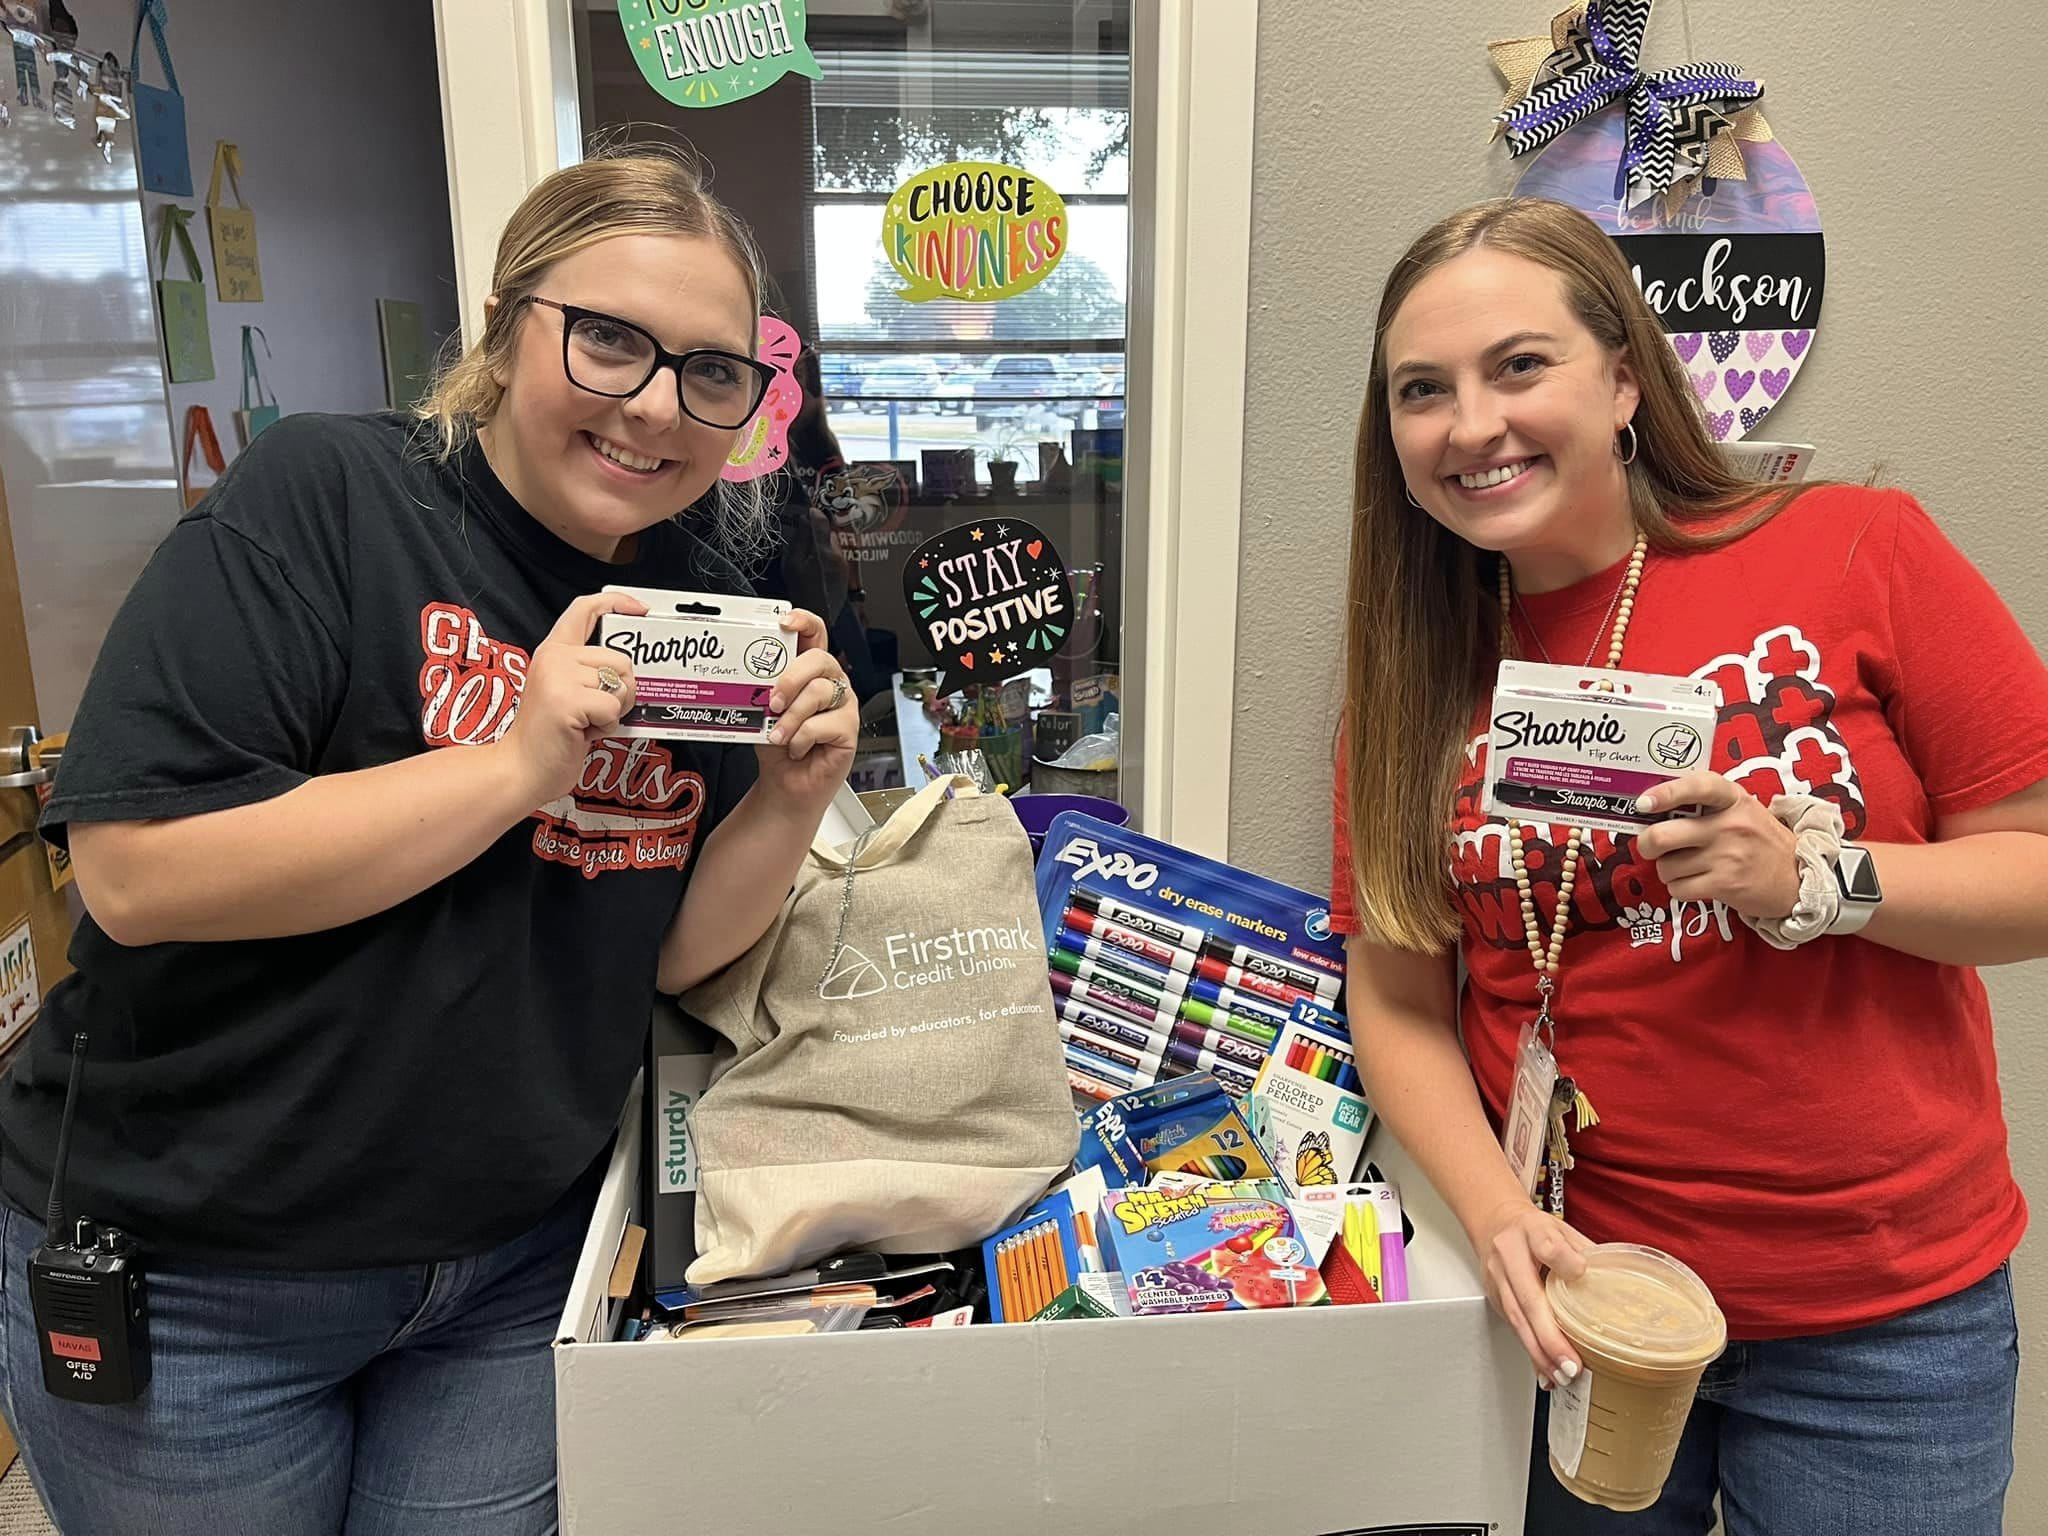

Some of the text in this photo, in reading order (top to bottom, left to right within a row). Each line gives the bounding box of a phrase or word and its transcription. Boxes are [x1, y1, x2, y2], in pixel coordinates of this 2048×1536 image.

[655, 0, 794, 80] ENOUGH
[909, 171, 1035, 222] CHOOSE
[895, 215, 1061, 291] KINDNESS
[937, 538, 1028, 608] STAY
[928, 584, 1064, 651] POSITIVE
[605, 630, 724, 667] Sharpie
[693, 664, 709, 676] Flip
[661, 704, 713, 723] Sharpie
[1493, 711, 1626, 751] Sharpie
[1589, 748, 1607, 761] Flip
[1550, 789, 1608, 810] Sharpie
[585, 849, 626, 873] you
[635, 835, 689, 864] belong
[1055, 838, 1158, 889] EXPO
[1115, 912, 1153, 931] EXPO
[1158, 887, 1288, 942] dry erase markers
[885, 917, 1038, 969] Firstmark
[1105, 929, 1145, 951] EXPO
[1631, 924, 1661, 939] GFES
[1248, 959, 1287, 978] EXPO
[1292, 947, 1344, 972] low odor ink
[894, 963, 954, 990] Credit
[833, 1027, 887, 1043] Founded
[891, 1026, 907, 1039] by
[911, 1016, 976, 1032] educators,
[979, 1008, 998, 1021] for
[1080, 1015, 1118, 1035] EXPO
[1298, 1004, 1319, 1025] 12
[1220, 1039, 1260, 1060] EXPO
[1117, 1096, 1145, 1111] 12
[1266, 1087, 1316, 1113] PENCILS
[1270, 1078, 1323, 1106] COLORED
[1095, 1101, 1126, 1141] EXPO
[1338, 1110, 1361, 1129] GEAR
[664, 1090, 690, 1185] sturdy
[1211, 1128, 1244, 1150] 12
[1114, 1194, 1209, 1235] SKETCH
[49, 1271, 92, 1281] MOTOROLA
[1134, 1270, 1167, 1289] 14
[1138, 1290, 1177, 1299] SCENTED
[1140, 1292, 1229, 1306] WASHABLE MARKERS
[66, 1360, 97, 1372] GFES
